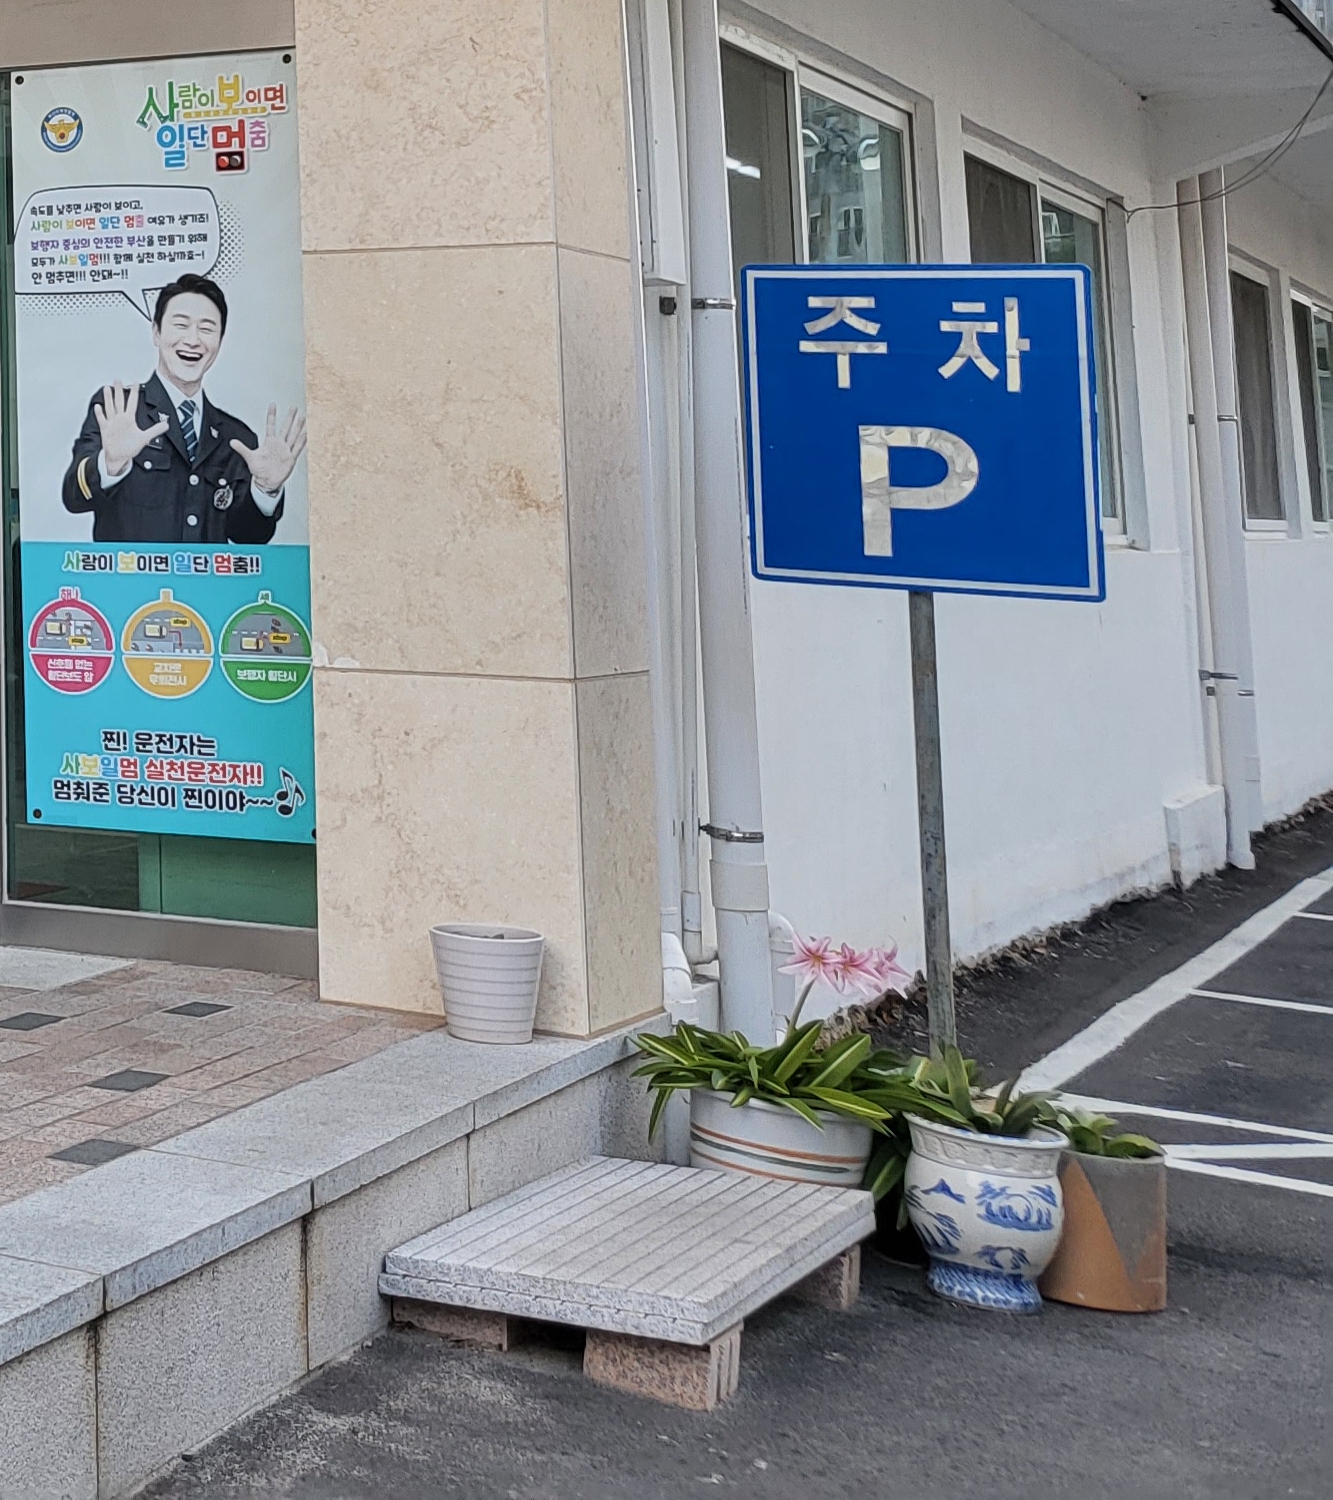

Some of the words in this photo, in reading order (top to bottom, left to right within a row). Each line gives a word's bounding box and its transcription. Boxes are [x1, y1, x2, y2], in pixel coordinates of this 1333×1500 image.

[136, 81, 215, 128] 사람이
[218, 74, 288, 114] 보이면
[157, 124, 209, 169] 일단
[212, 119, 268, 171] 멈춤
[83, 201, 111, 213] 사람이
[30, 219, 62, 232] 사람이
[65, 217, 95, 230] 보이면
[98, 215, 120, 229] 일단
[146, 214, 175, 225] 여유가
[30, 239, 59, 252] 보행자
[62, 237, 90, 251] 중심의
[92, 235, 123, 249] 안전한
[126, 234, 154, 247] 부산을
[187, 232, 207, 244] 위해
[31, 256, 56, 268] 모두가
[112, 253, 133, 264] 함께
[135, 251, 154, 263] 실천
[31, 272, 42, 285] 안
[45, 270, 85, 284] 멈추면!!!
[858, 424, 979, 557] P
[63, 551, 112, 571] 사람이
[118, 552, 169, 572] 보이면
[174, 553, 209, 573] 일단
[214, 553, 260, 574] 멈춤!!
[102, 730, 127, 750] 찐!
[134, 731, 216, 755] 운전자는
[60, 753, 138, 777] 사보일멈
[144, 757, 263, 785] 실천운전자!!
[53, 778, 109, 803] 멈춰준
[116, 784, 176, 808] 당신이
